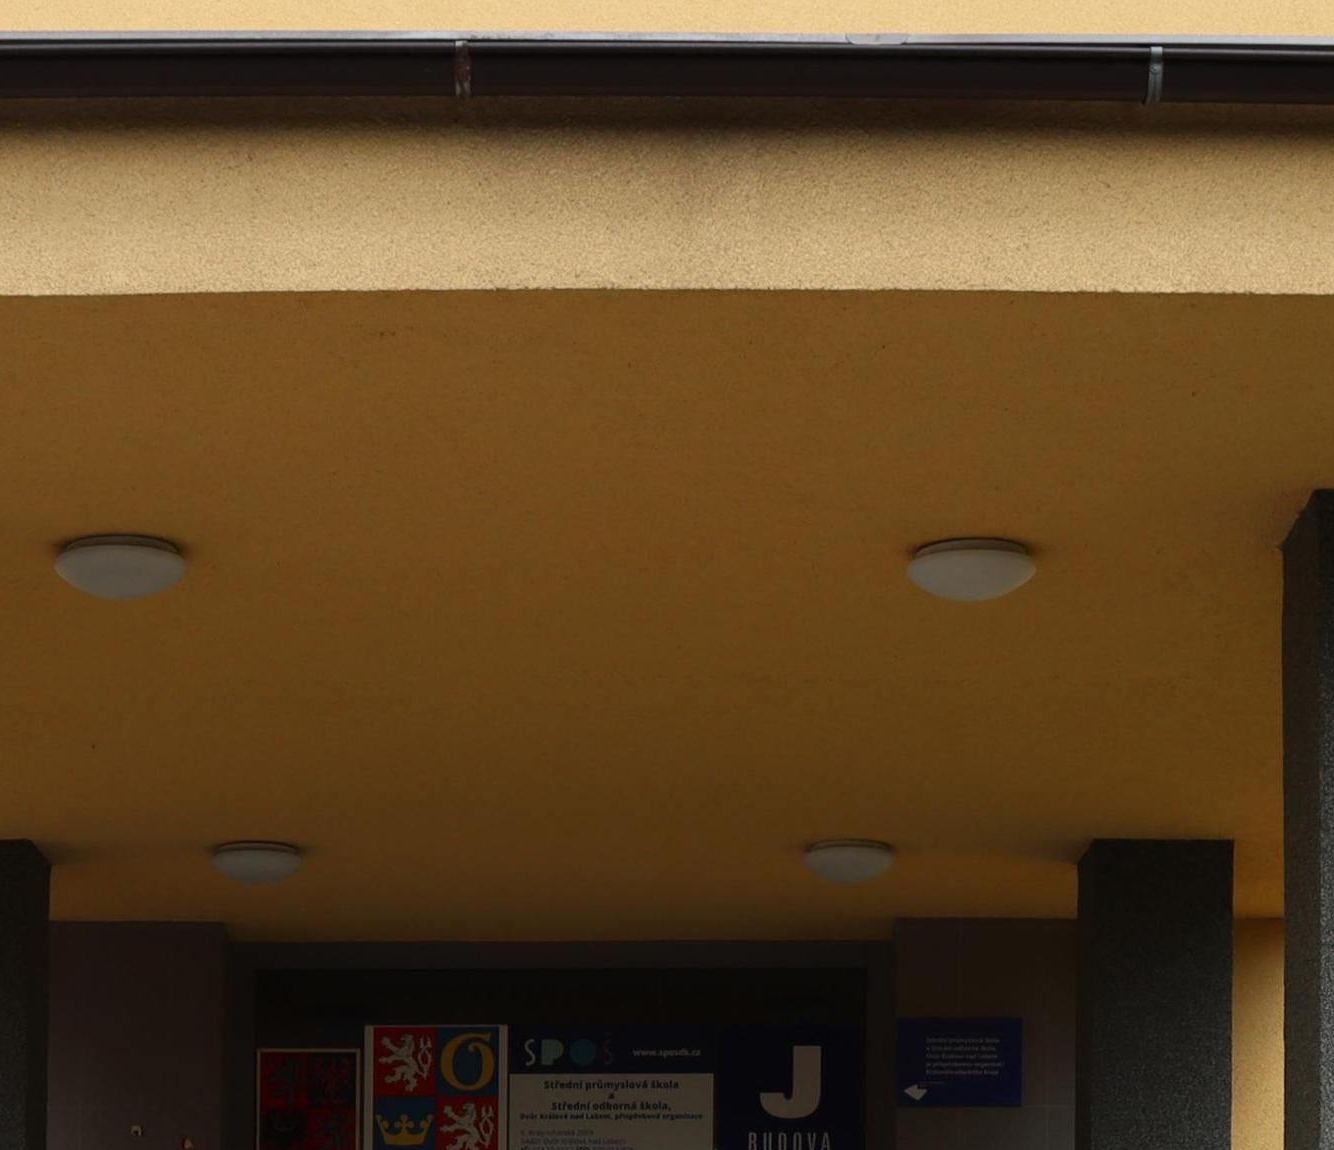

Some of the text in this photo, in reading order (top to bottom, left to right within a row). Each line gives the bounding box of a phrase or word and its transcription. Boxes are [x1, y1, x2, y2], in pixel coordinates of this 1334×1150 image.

[544, 1079, 680, 1092] Střední průmyslová škola
[759, 1045, 822, 1119] J
[608, 1092, 616, 1100] a
[552, 1101, 671, 1112] Střední odborná škola,
